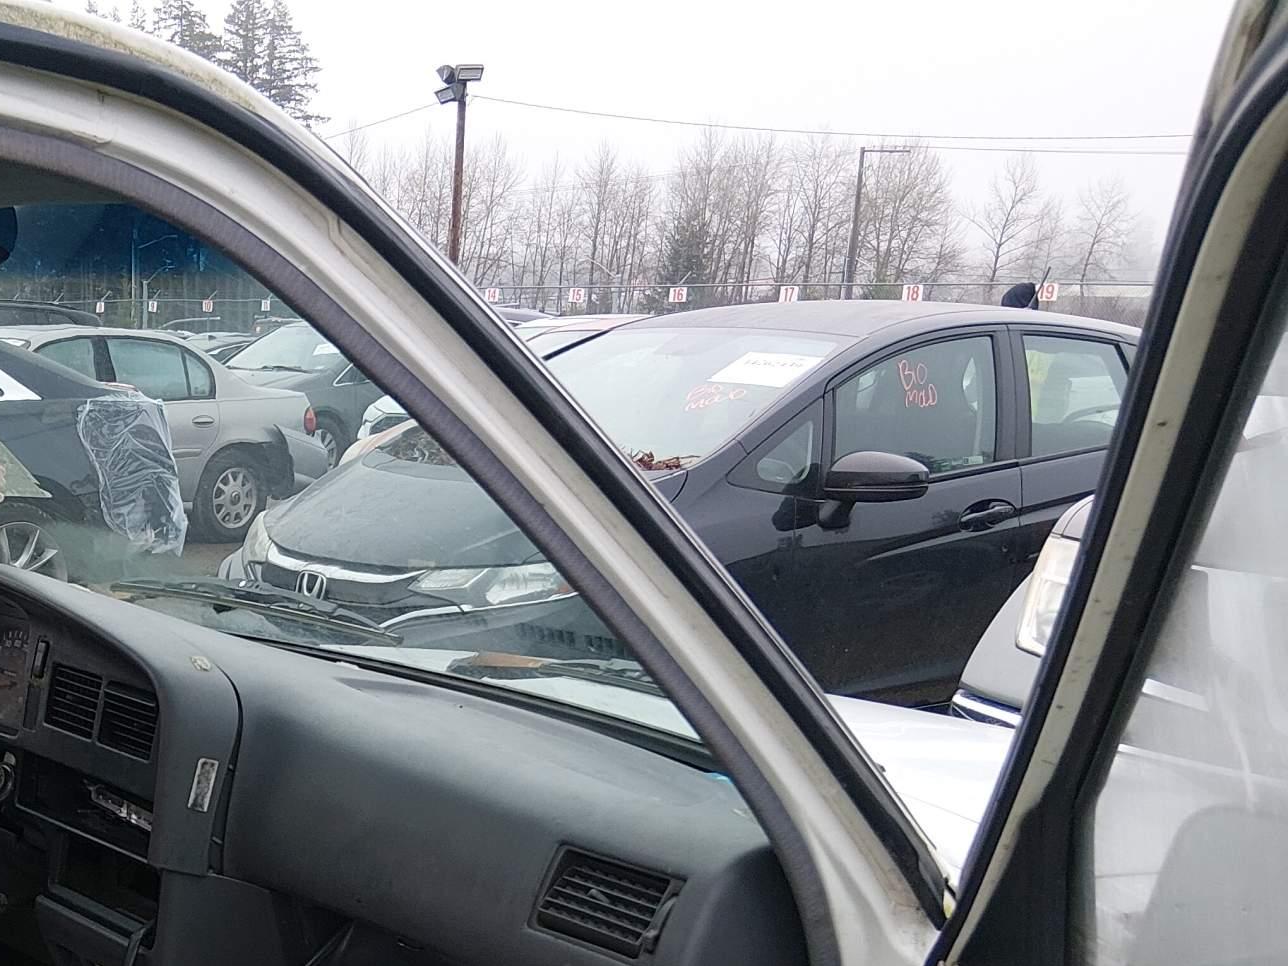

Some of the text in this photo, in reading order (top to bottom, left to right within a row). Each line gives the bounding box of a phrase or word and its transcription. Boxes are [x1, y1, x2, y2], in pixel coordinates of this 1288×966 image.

[487, 288, 497, 301] 14
[572, 288, 582, 301] 15
[672, 288, 684, 302] 16
[784, 287, 795, 301] 17
[906, 285, 920, 301] 18
[1039, 284, 1055, 300] 19
